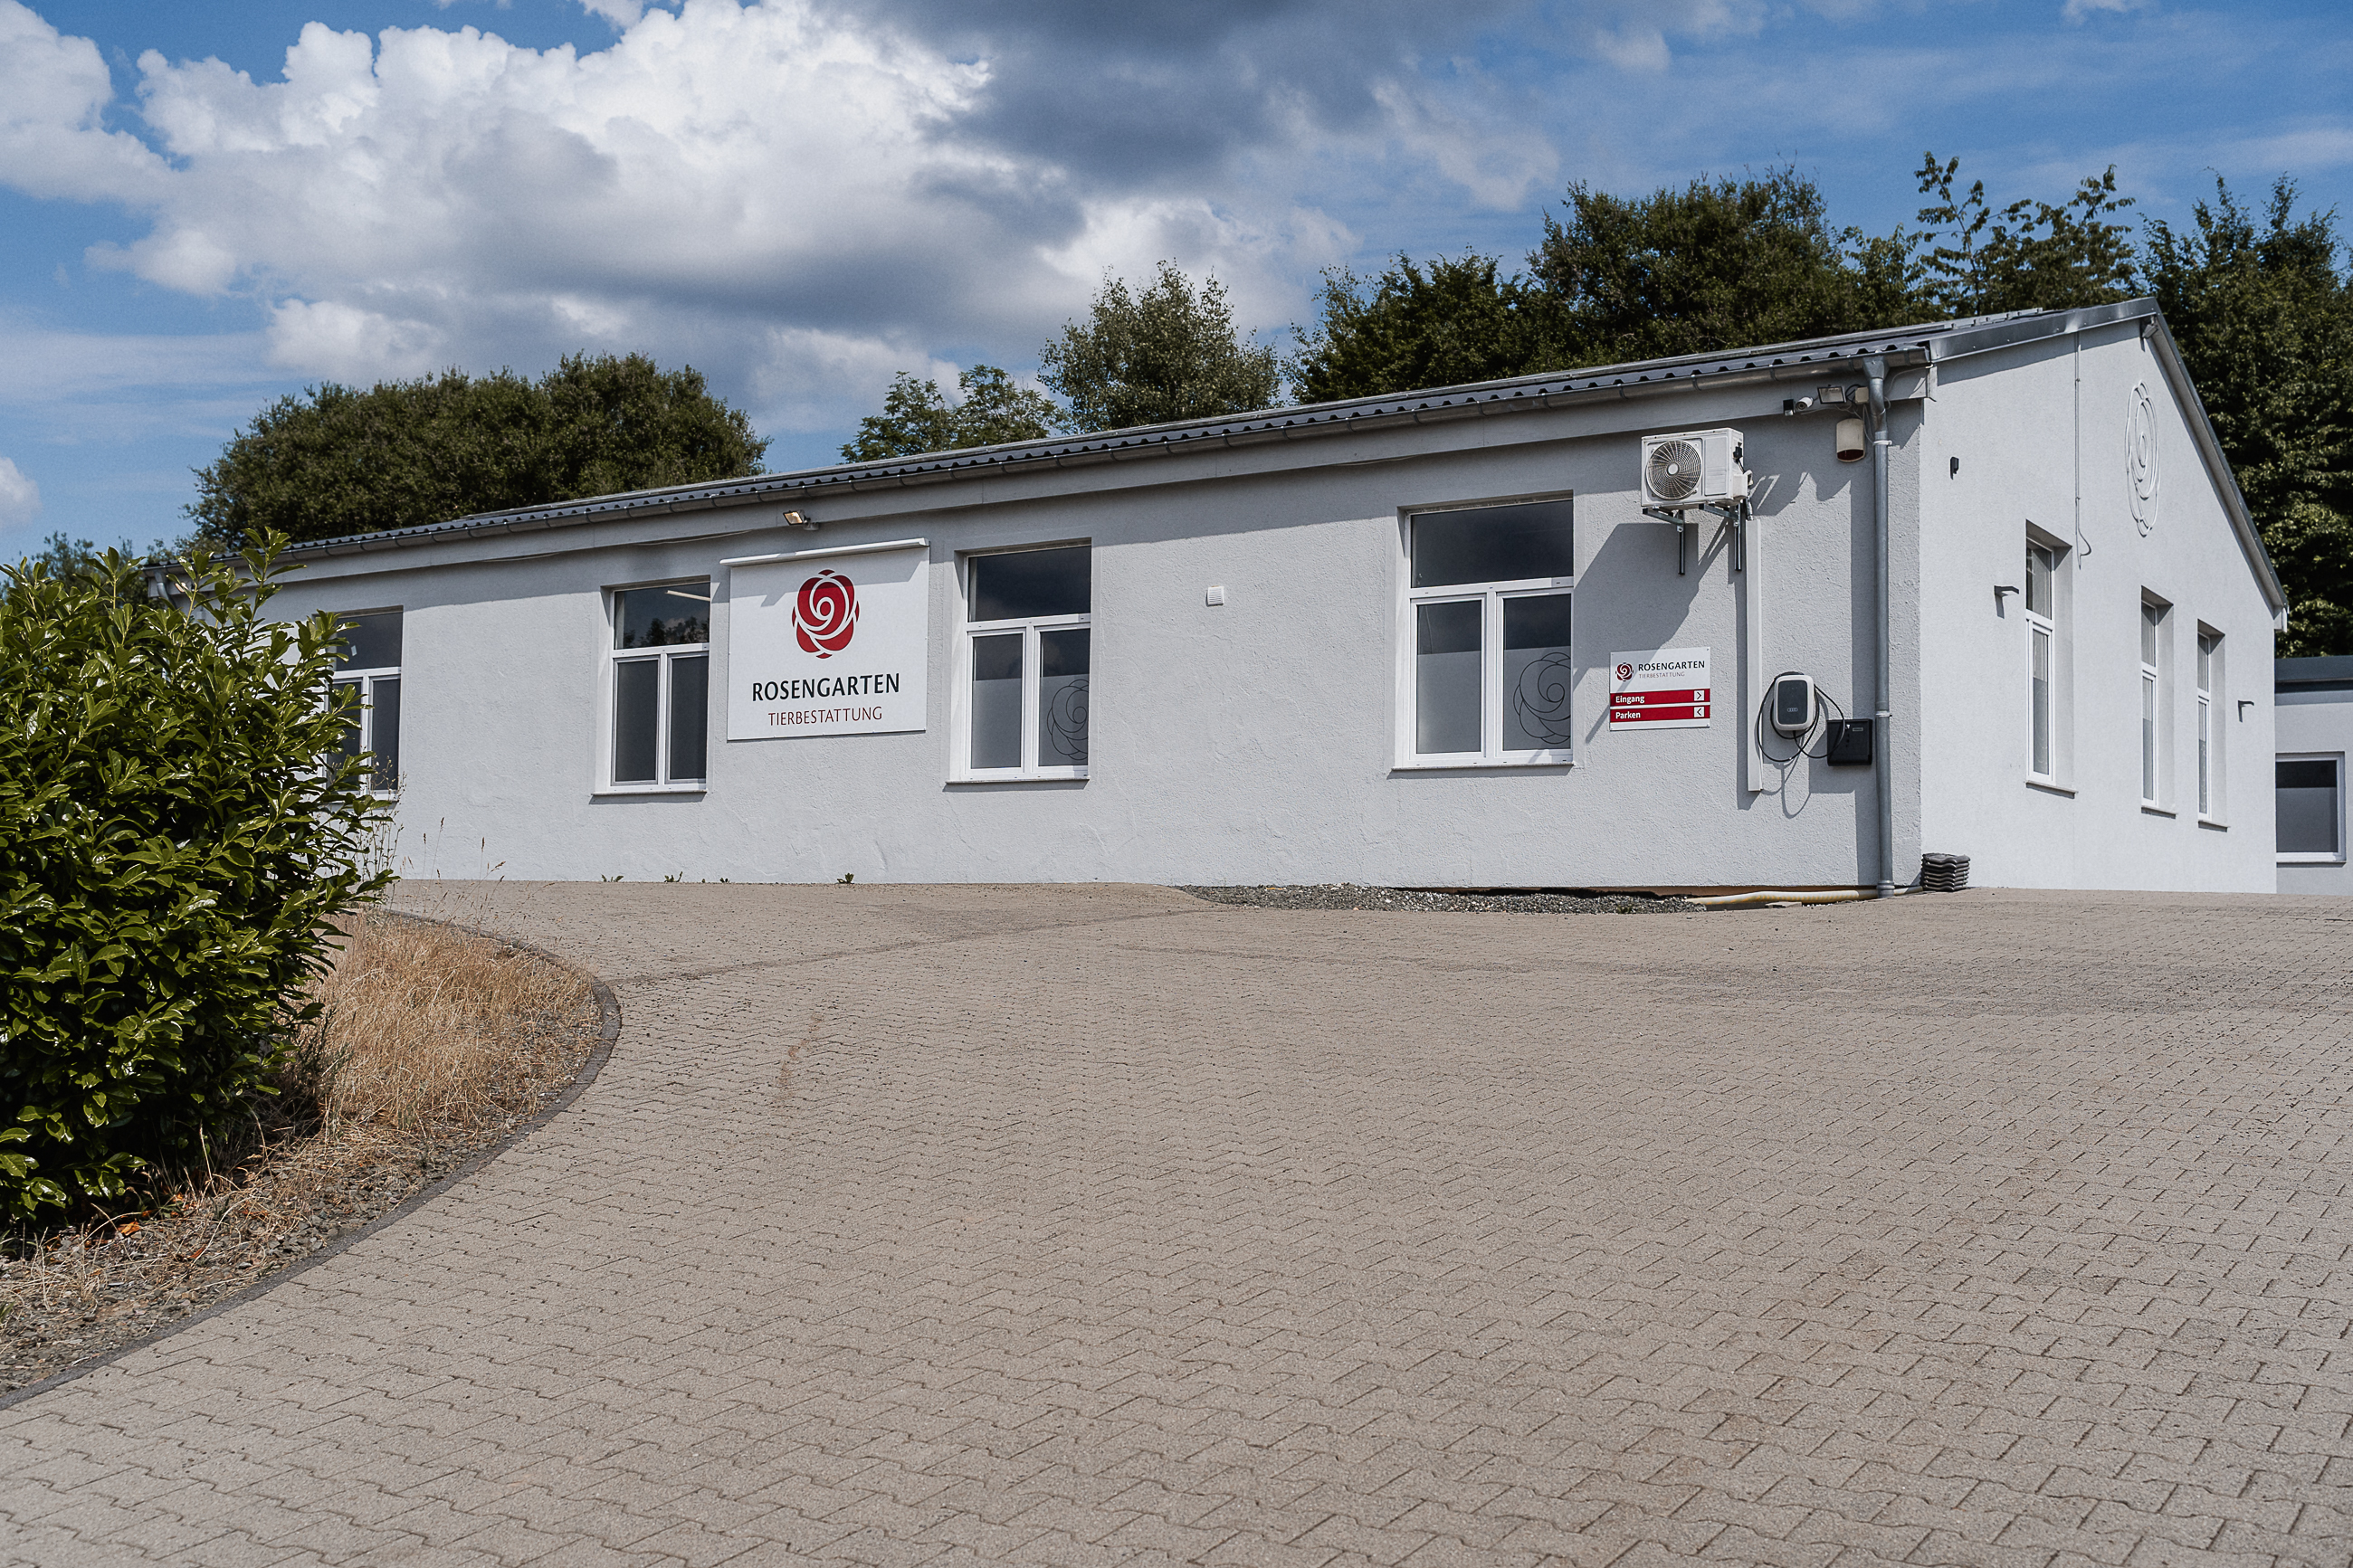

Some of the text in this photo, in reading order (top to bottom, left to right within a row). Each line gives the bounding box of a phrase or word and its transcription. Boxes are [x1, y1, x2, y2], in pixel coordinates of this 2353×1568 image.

[1638, 660, 1705, 671] ROSENGARTEN
[752, 672, 900, 701] ROSENGARTEN
[1615, 696, 1645, 704] Eingang
[768, 706, 882, 726] TIERBESTATTUNG
[1615, 711, 1641, 719] Parken
